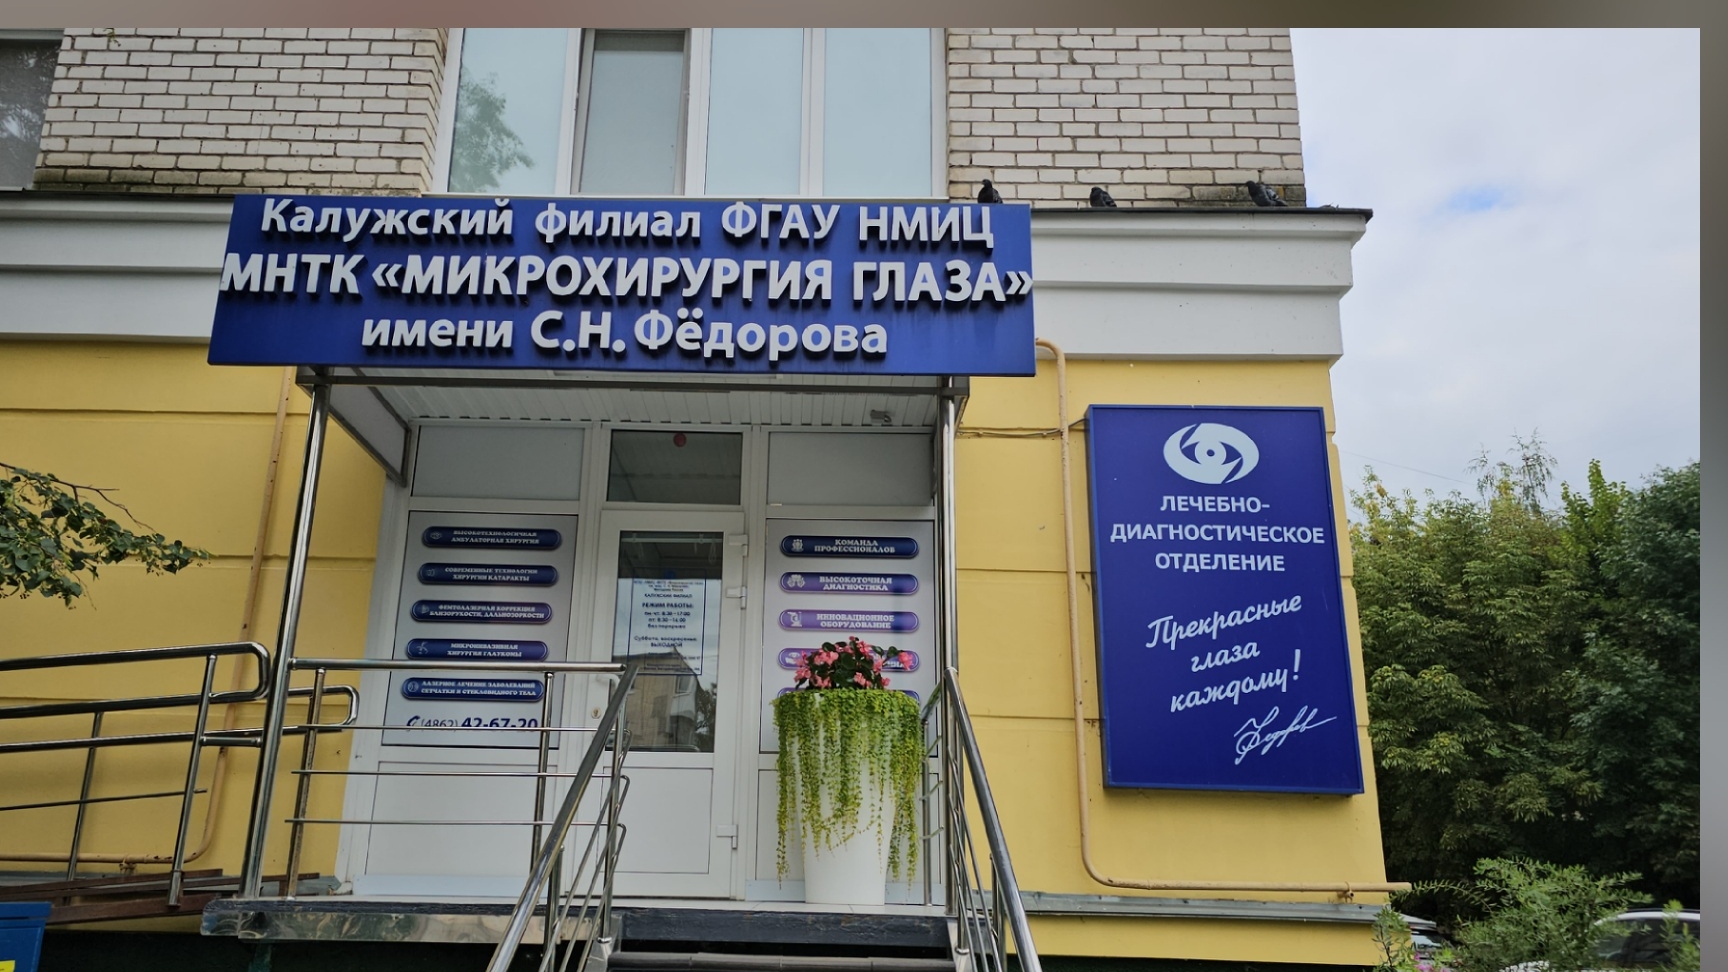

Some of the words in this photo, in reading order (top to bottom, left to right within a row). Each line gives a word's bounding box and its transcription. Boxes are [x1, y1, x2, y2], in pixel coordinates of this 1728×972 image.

[261, 198, 513, 242] Калужский
[535, 202, 700, 243] филиал
[721, 201, 840, 239] ФГАУ
[859, 206, 994, 248] НМИЦ
[219, 253, 365, 294] МНТК
[371, 254, 832, 300] «МИКРОХИРУРГИЯ
[853, 259, 1033, 302] ГЛАЗА»
[361, 318, 513, 348] имени
[530, 310, 626, 352] С.Н.
[634, 307, 888, 362] Фёдорова
[1160, 495, 1270, 514] ЛЕЧЕБНО-
[1110, 523, 1325, 544] ДИАГНОСТИЧЕСКОЕ
[1154, 552, 1285, 573] ОТДЕЛЕНИЕ
[819, 576, 892, 584] ВЫСОКОТОЧНАЯ
[823, 583, 888, 591] ДИАГНОСТИКА
[816, 614, 894, 622] ИННОВАЦИОННОЕ
[820, 621, 891, 629] ОБОРУДОВАНИЕ
[1145, 594, 1302, 650] Прекрасные
[1190, 641, 1260, 673] глаза
[1170, 649, 1301, 713] каждому!
[461, 717, 538, 728] 42-67-20
